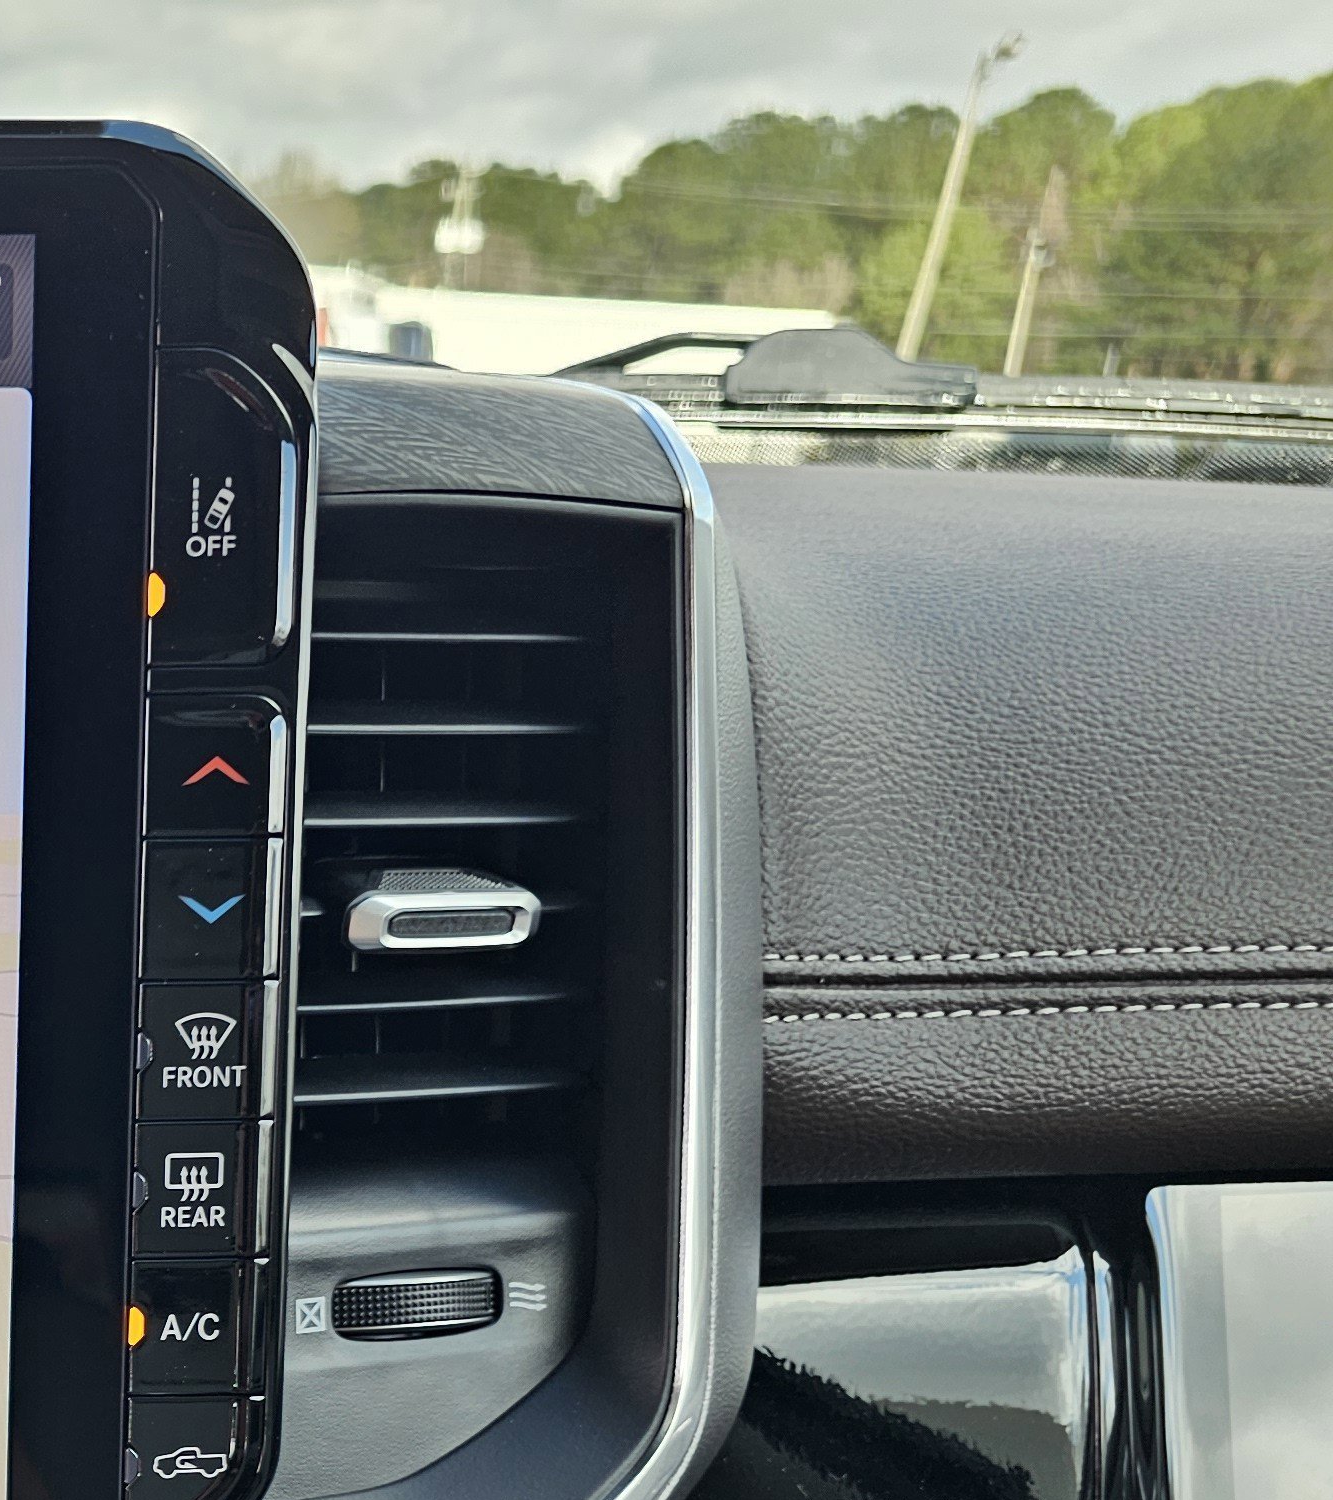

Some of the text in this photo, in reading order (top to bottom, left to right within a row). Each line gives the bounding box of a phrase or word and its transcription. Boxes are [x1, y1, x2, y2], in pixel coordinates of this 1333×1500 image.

[185, 535, 237, 557] OFF
[162, 1065, 247, 1088] FRONT
[160, 1206, 226, 1228] REAR
[160, 1312, 221, 1341] A/C
